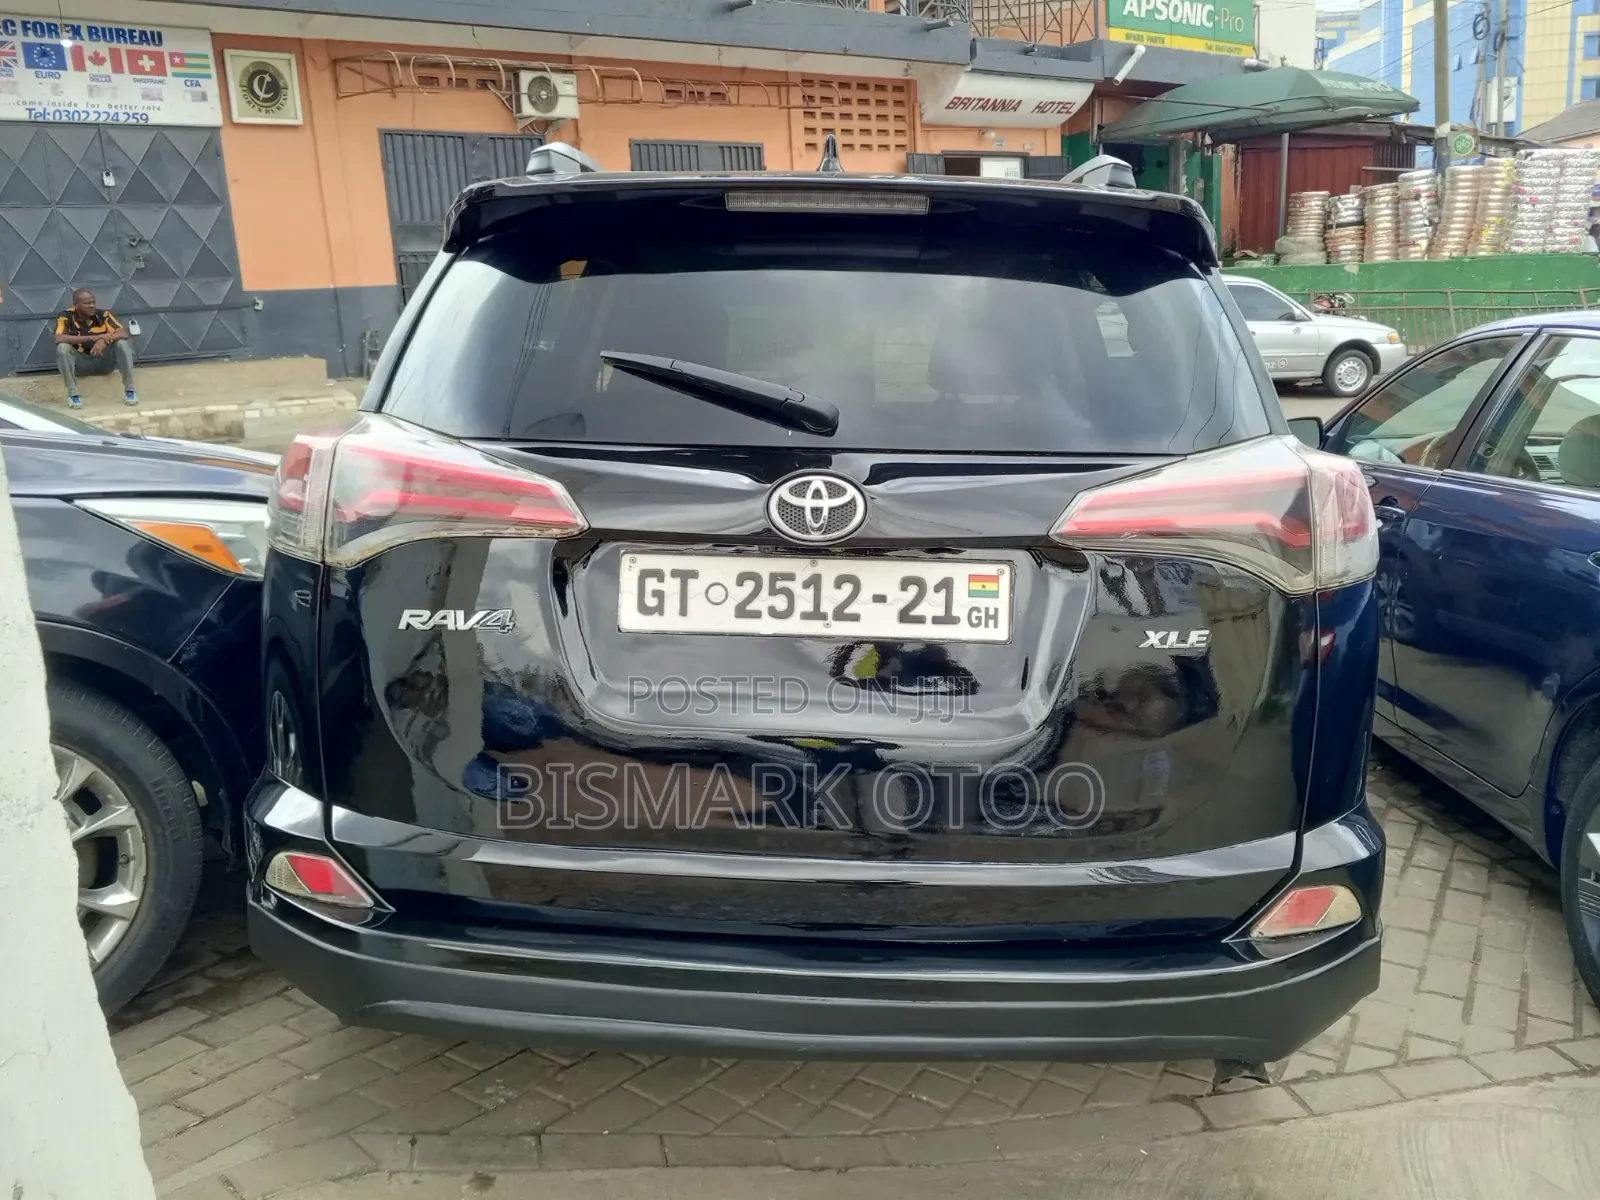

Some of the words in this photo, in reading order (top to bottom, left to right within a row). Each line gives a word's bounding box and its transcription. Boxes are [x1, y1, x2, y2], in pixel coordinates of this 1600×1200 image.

[1122, 0, 1215, 28] APSONIC
[1221, 7, 1245, 33] Pro
[0, 18, 17, 37] C
[20, 20, 85, 41] FOREX
[86, 25, 164, 47] BUREAU
[1146, 35, 1166, 45] PARTS
[35, 70, 62, 80] EURO
[184, 79, 202, 88] CFA
[46, 99, 79, 108] inside
[86, 101, 100, 109] for
[944, 96, 1022, 113] BRITANNIA
[1030, 101, 1076, 115] HOTEL
[637, 568, 699, 617] GT
[397, 608, 516, 634] RAV4
[967, 606, 1000, 629] GH
[1137, 628, 1210, 649] XLE
